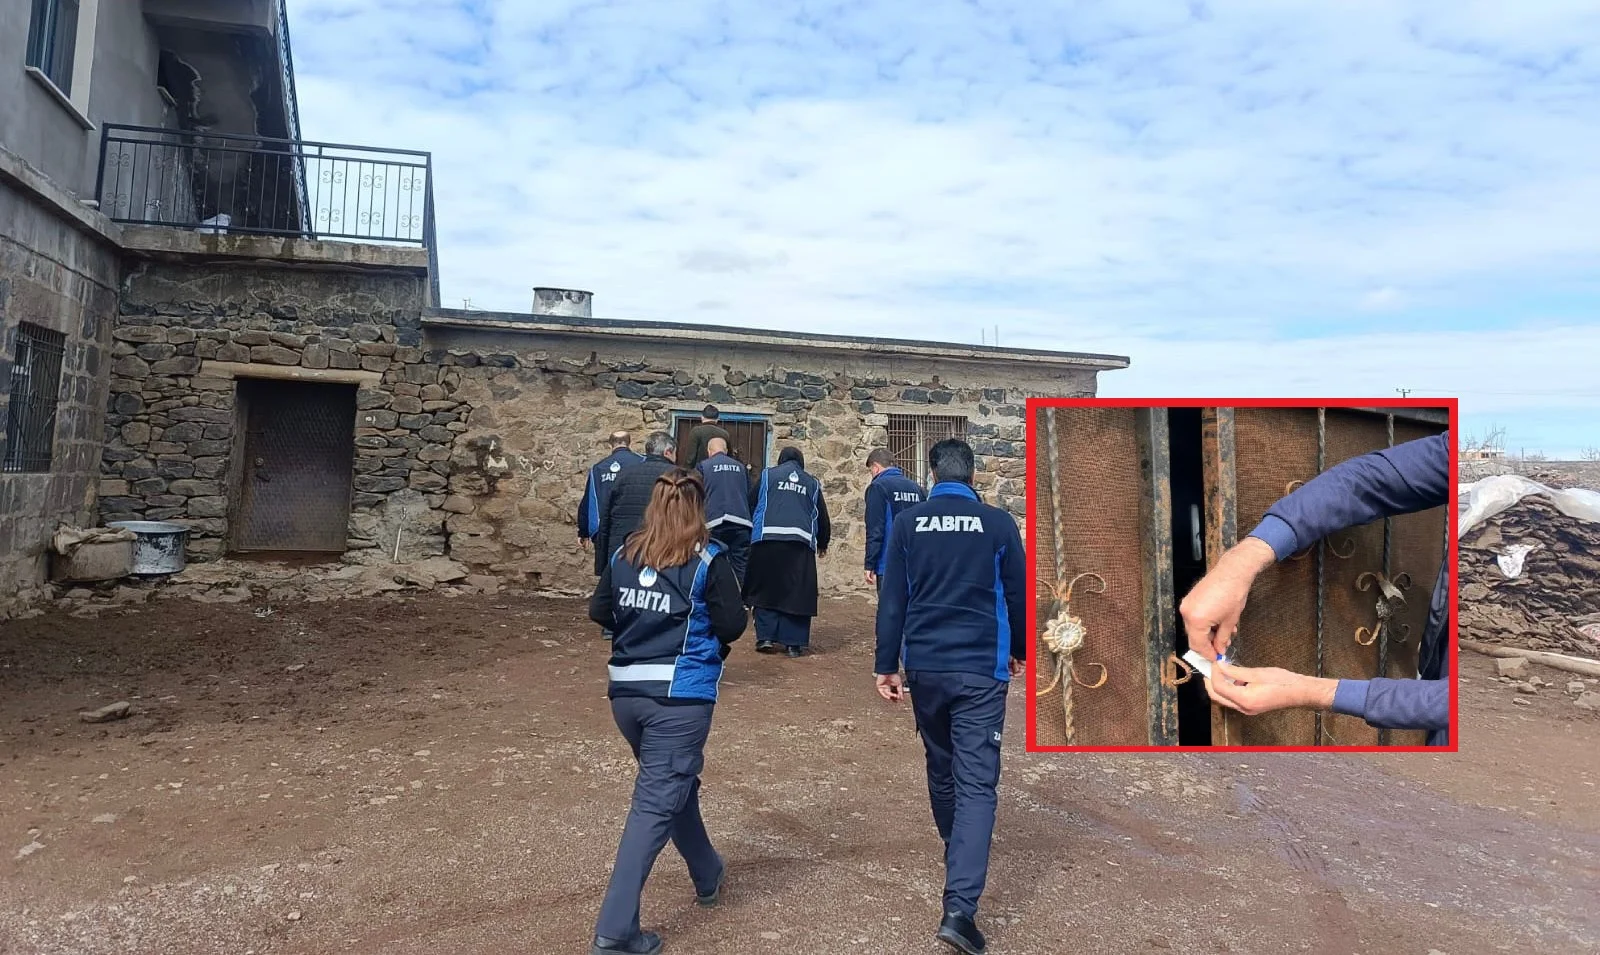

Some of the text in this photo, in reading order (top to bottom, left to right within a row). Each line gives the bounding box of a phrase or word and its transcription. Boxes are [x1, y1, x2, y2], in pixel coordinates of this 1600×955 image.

[713, 464, 741, 473] ZABITA
[778, 481, 807, 495] ZABITA
[893, 491, 920, 502] ZABITA
[915, 515, 984, 532] ZABITA
[619, 586, 671, 614] ZABITA
